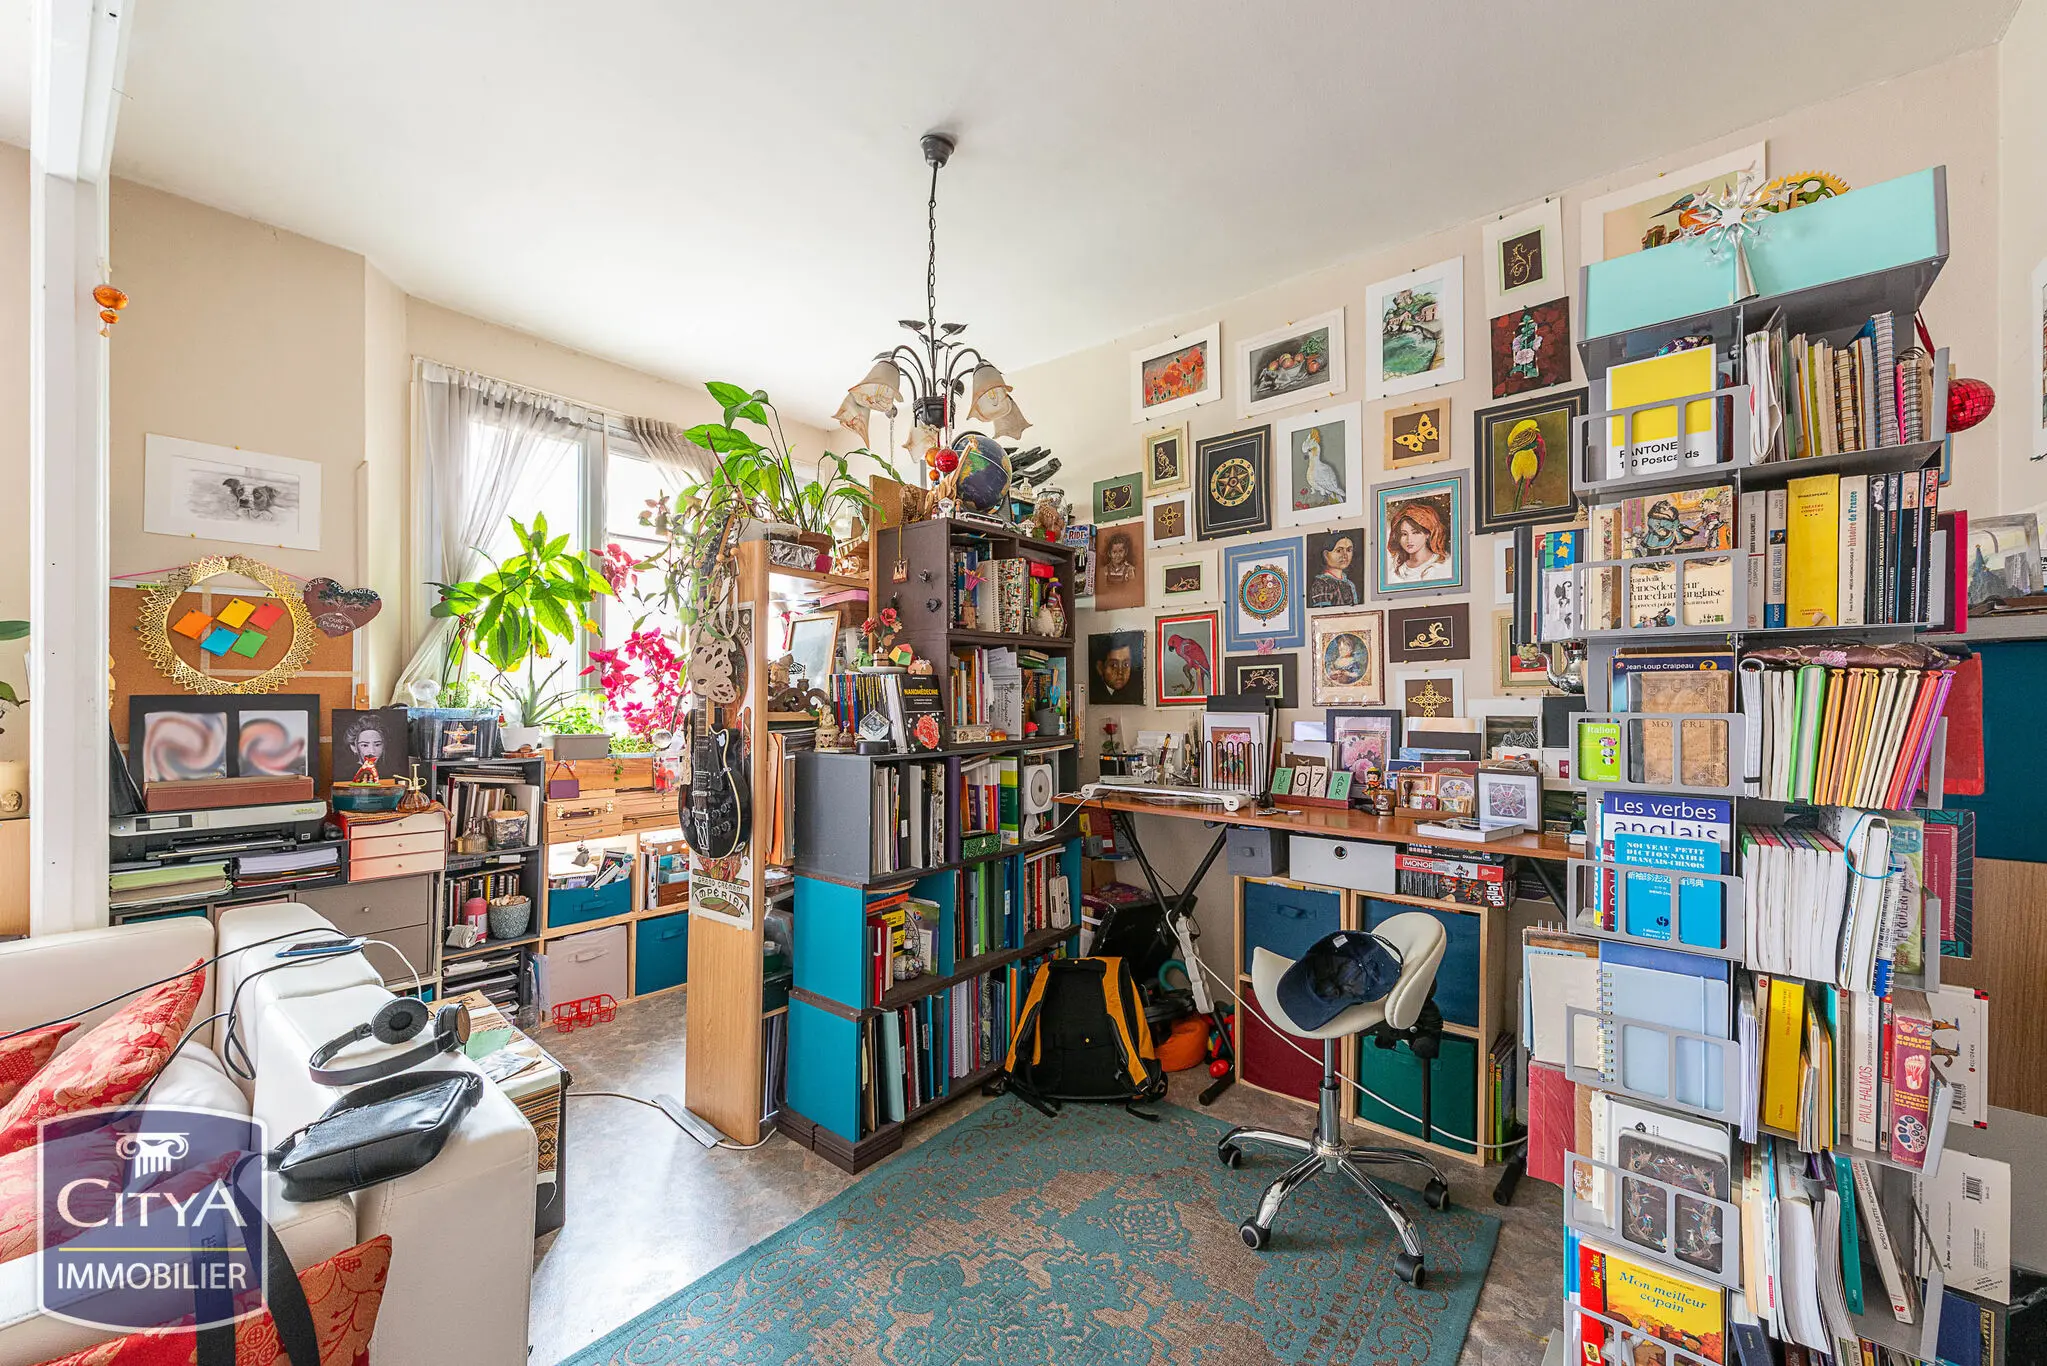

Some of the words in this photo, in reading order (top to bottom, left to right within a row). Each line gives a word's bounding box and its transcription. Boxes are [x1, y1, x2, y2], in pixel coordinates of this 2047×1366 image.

[1620, 459, 1638, 468] 10
[1642, 450, 1700, 466] Postcads
[1848, 491, 1857, 514] France
[1848, 522, 1857, 547] histoire
[305, 578, 324, 592] SAVE
[331, 582, 345, 593] AND
[350, 589, 380, 599] PROTECT
[323, 621, 349, 631] PLANET
[1588, 725, 1616, 734] Italien
[1277, 771, 1287, 790] TUE
[1297, 773, 1324, 787] 07
[1335, 776, 1344, 795] APR
[1615, 798, 1643, 814] Les
[1651, 802, 1716, 820] verbes
[1626, 849, 1704, 862] DICTIONNAIRE
[1627, 842, 1671, 851] NOUVEAU
[1675, 847, 1704, 855] PETIT
[1404, 860, 1432, 868] MONOP
[698, 877, 715, 886] GRAND
[1487, 881, 1505, 906] Jenga
[1897, 1034, 1931, 1045] CORPS
[1859, 1066, 1872, 1101] HALMOS
[1858, 1104, 1872, 1124] PAUL
[1853, 1163, 1865, 1190] SHAKESPEARE
[1619, 1272, 1650, 1290] Mon
[1654, 1287, 1707, 1309] meilleur
[1640, 1293, 1684, 1313] copain
